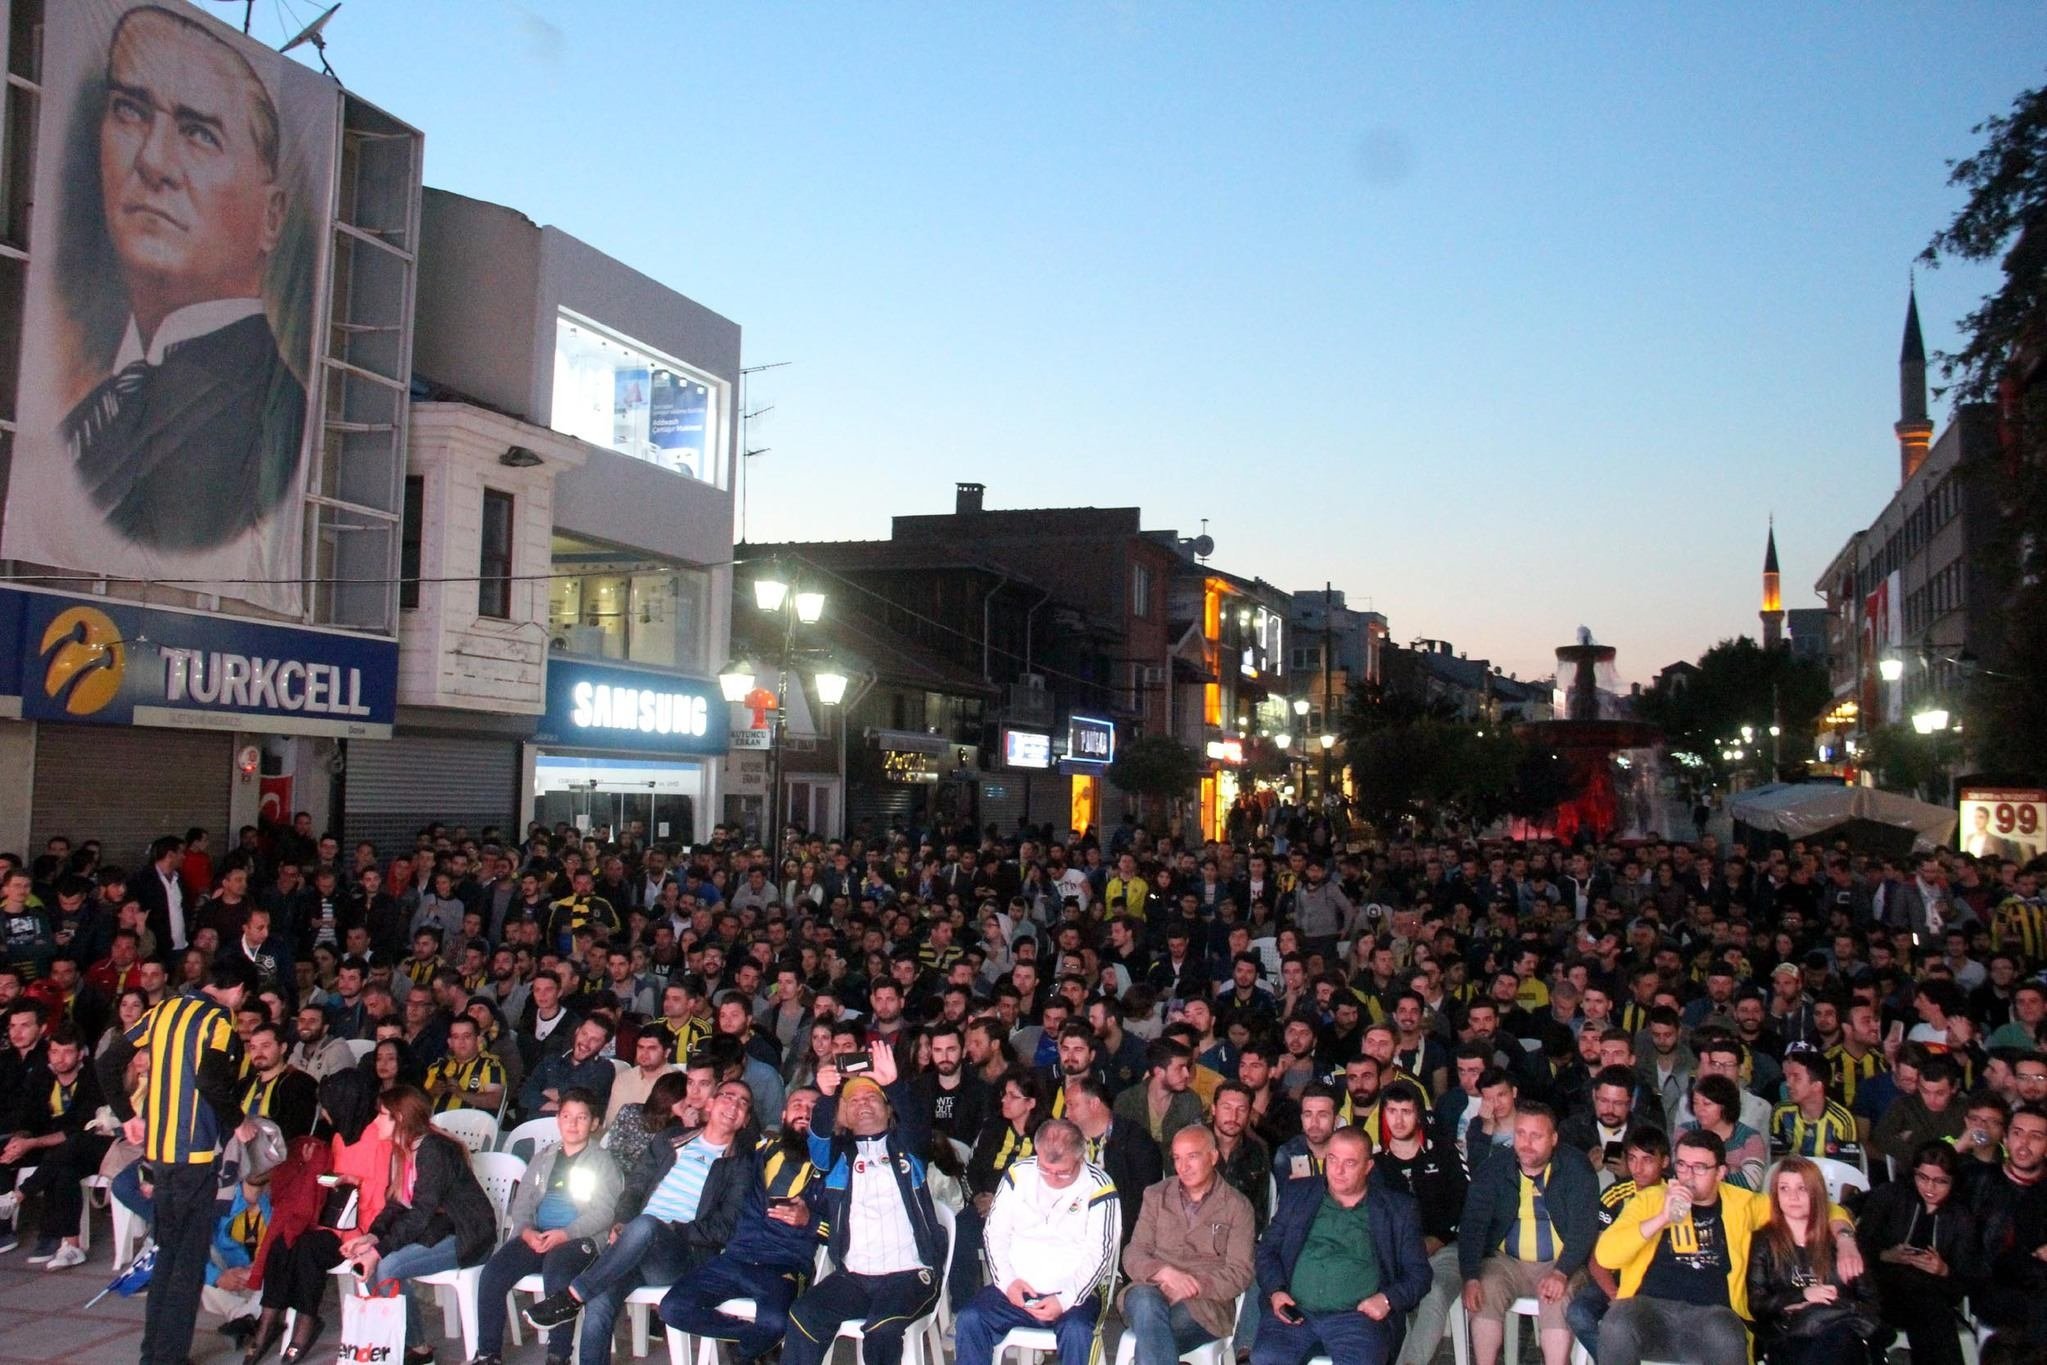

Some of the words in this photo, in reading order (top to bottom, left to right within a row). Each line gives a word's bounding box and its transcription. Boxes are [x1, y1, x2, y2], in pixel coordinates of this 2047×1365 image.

[160, 646, 371, 715] TURKCELL
[573, 681, 707, 737] SAMSUNG
[1996, 803, 2038, 834] 99
